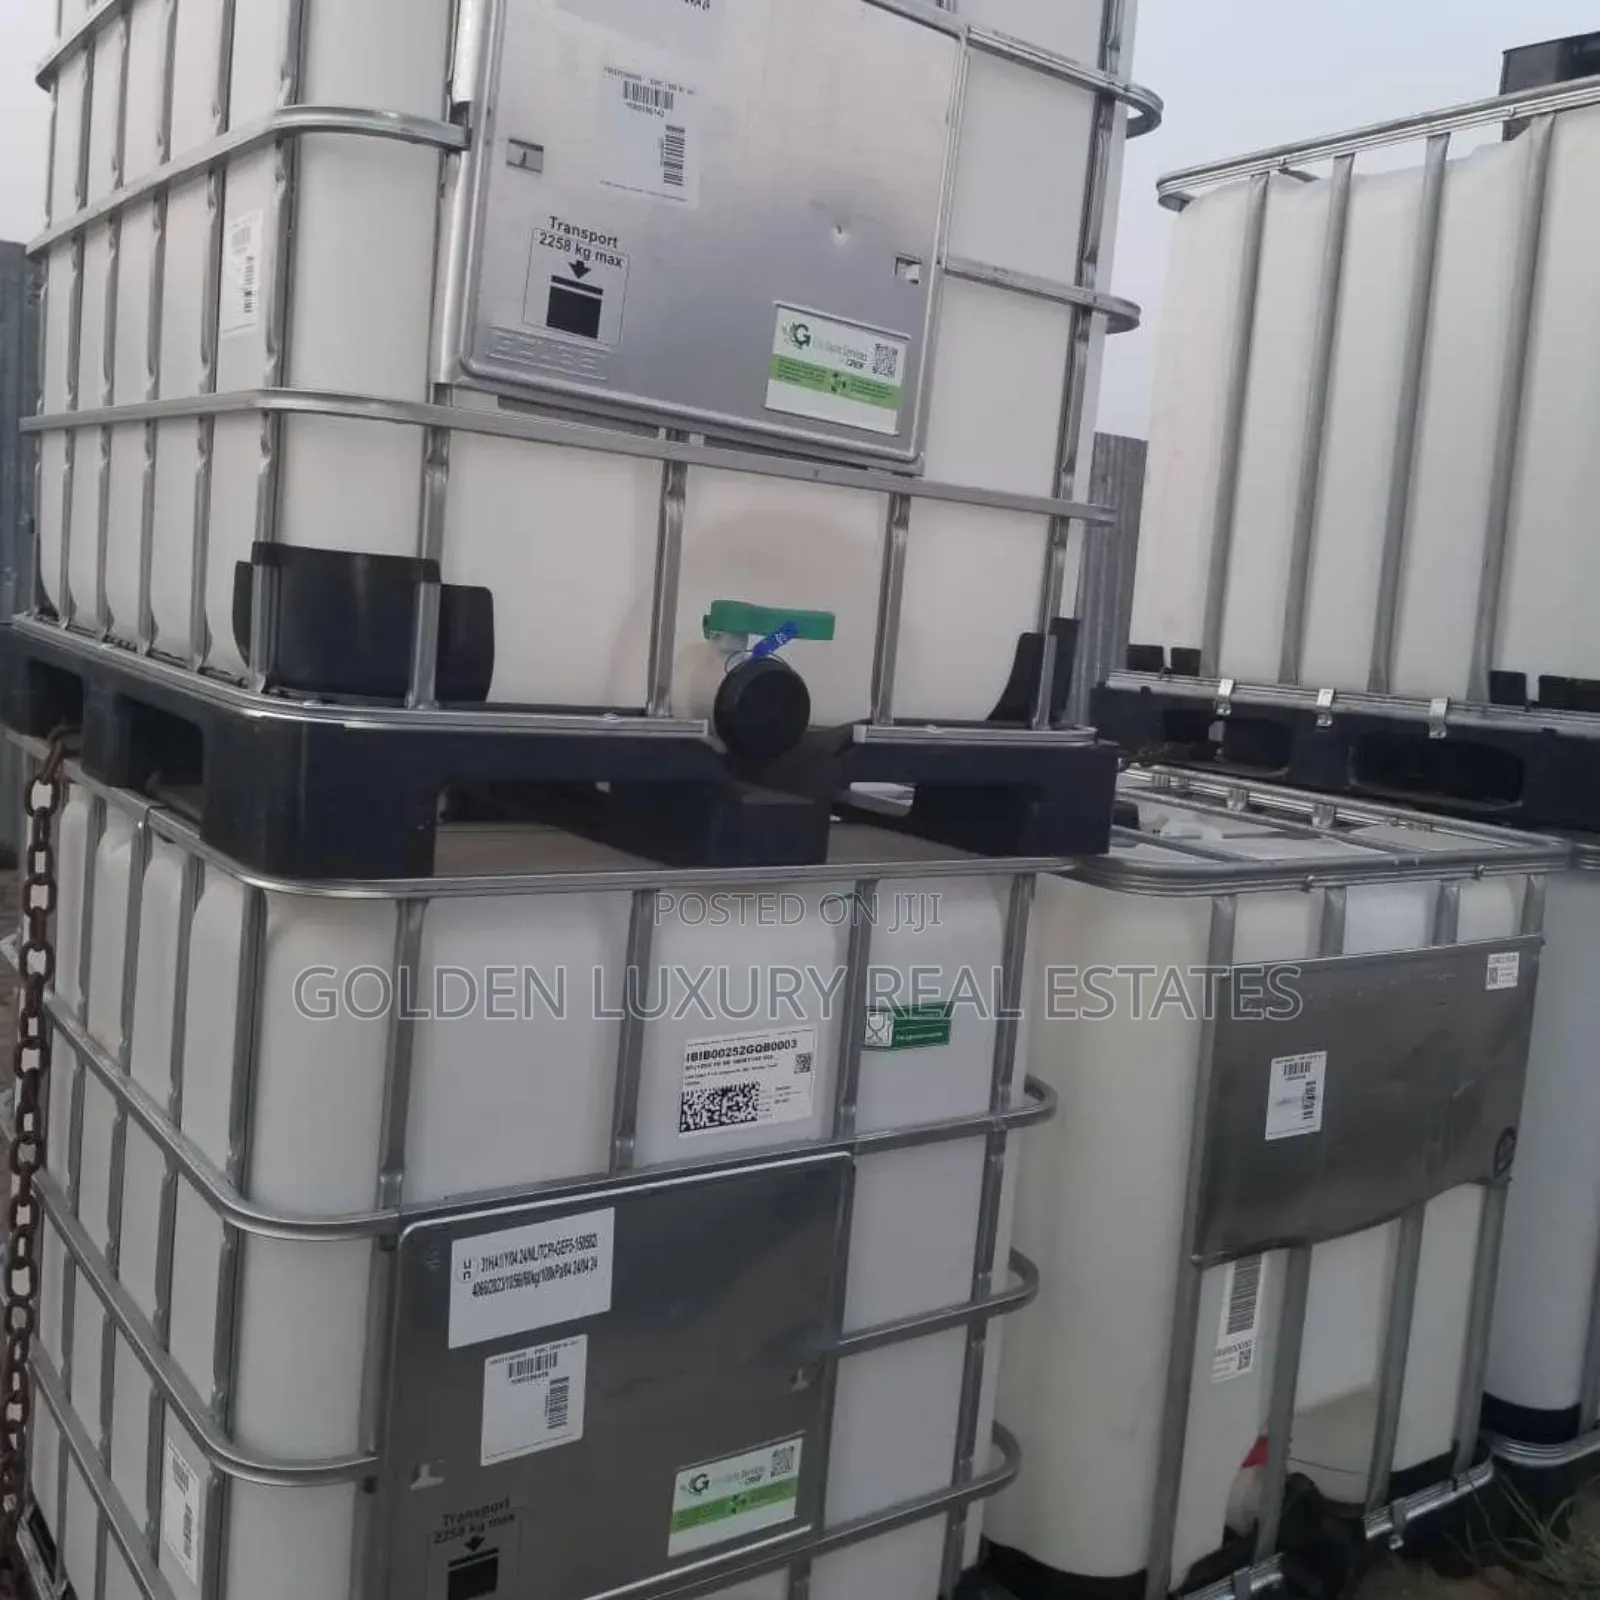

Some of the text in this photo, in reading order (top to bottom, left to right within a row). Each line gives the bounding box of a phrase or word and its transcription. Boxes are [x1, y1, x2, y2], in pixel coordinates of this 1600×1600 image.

[539, 231, 623, 268] 2258 kg max
[548, 215, 618, 249] Transport
